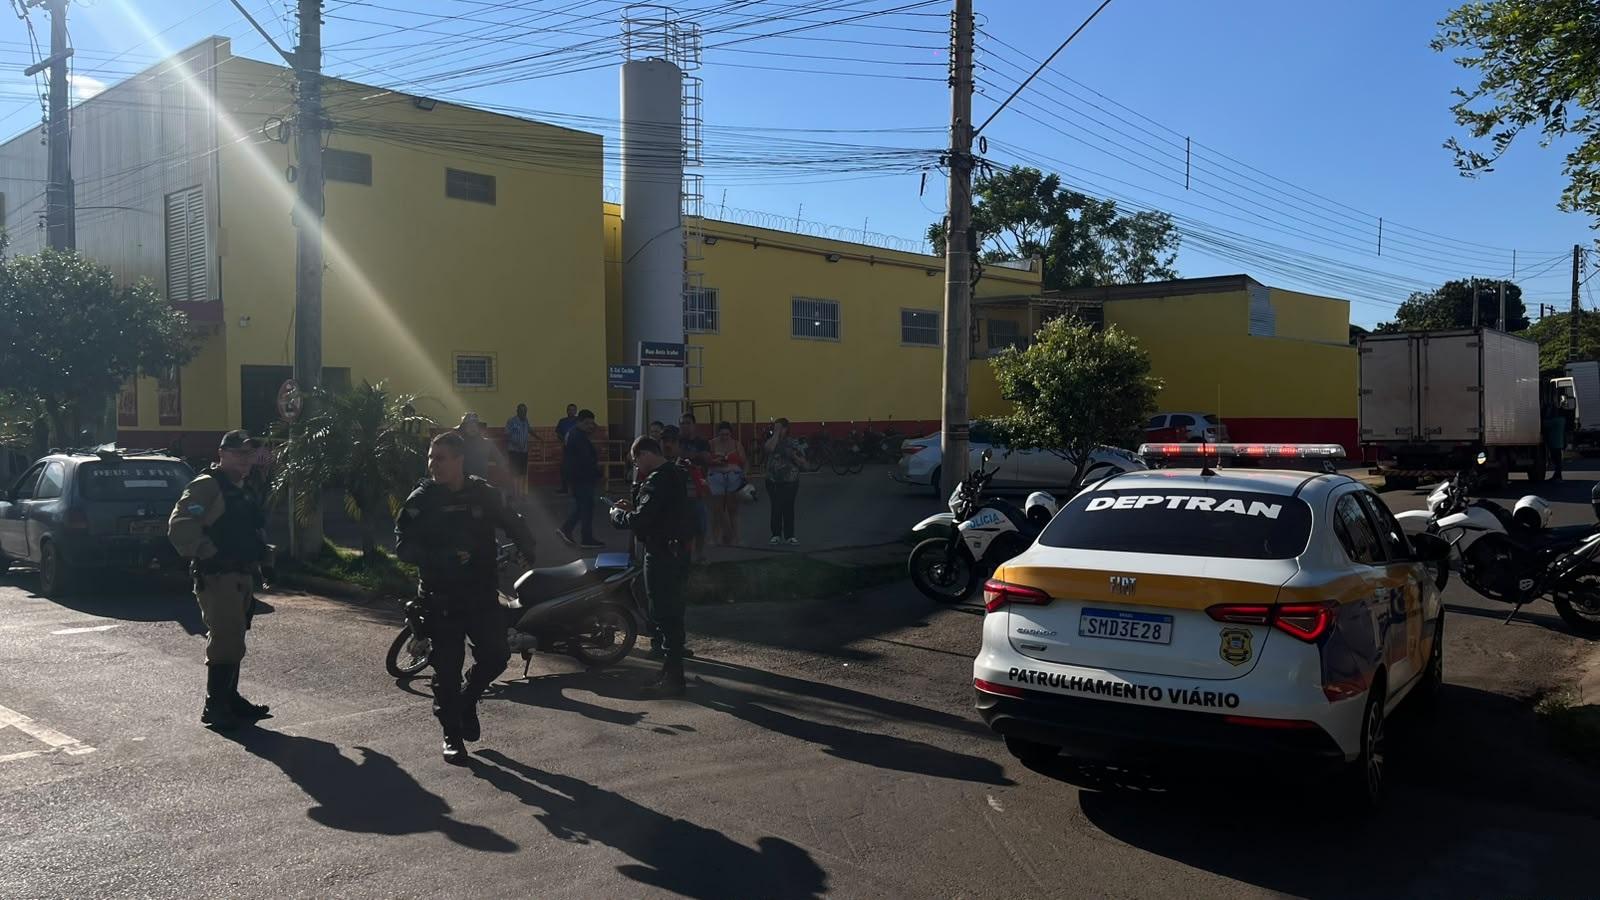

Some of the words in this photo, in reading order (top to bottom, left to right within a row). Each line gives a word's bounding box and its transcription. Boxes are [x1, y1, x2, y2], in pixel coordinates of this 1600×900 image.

[1085, 495, 1282, 519] DEPTRAN
[1110, 576, 1137, 596] FIAT
[1088, 618, 1162, 640] SMD3E28
[1008, 667, 1163, 702] PATRULHAMENTO
[1168, 686, 1240, 709] VIÁRIO
